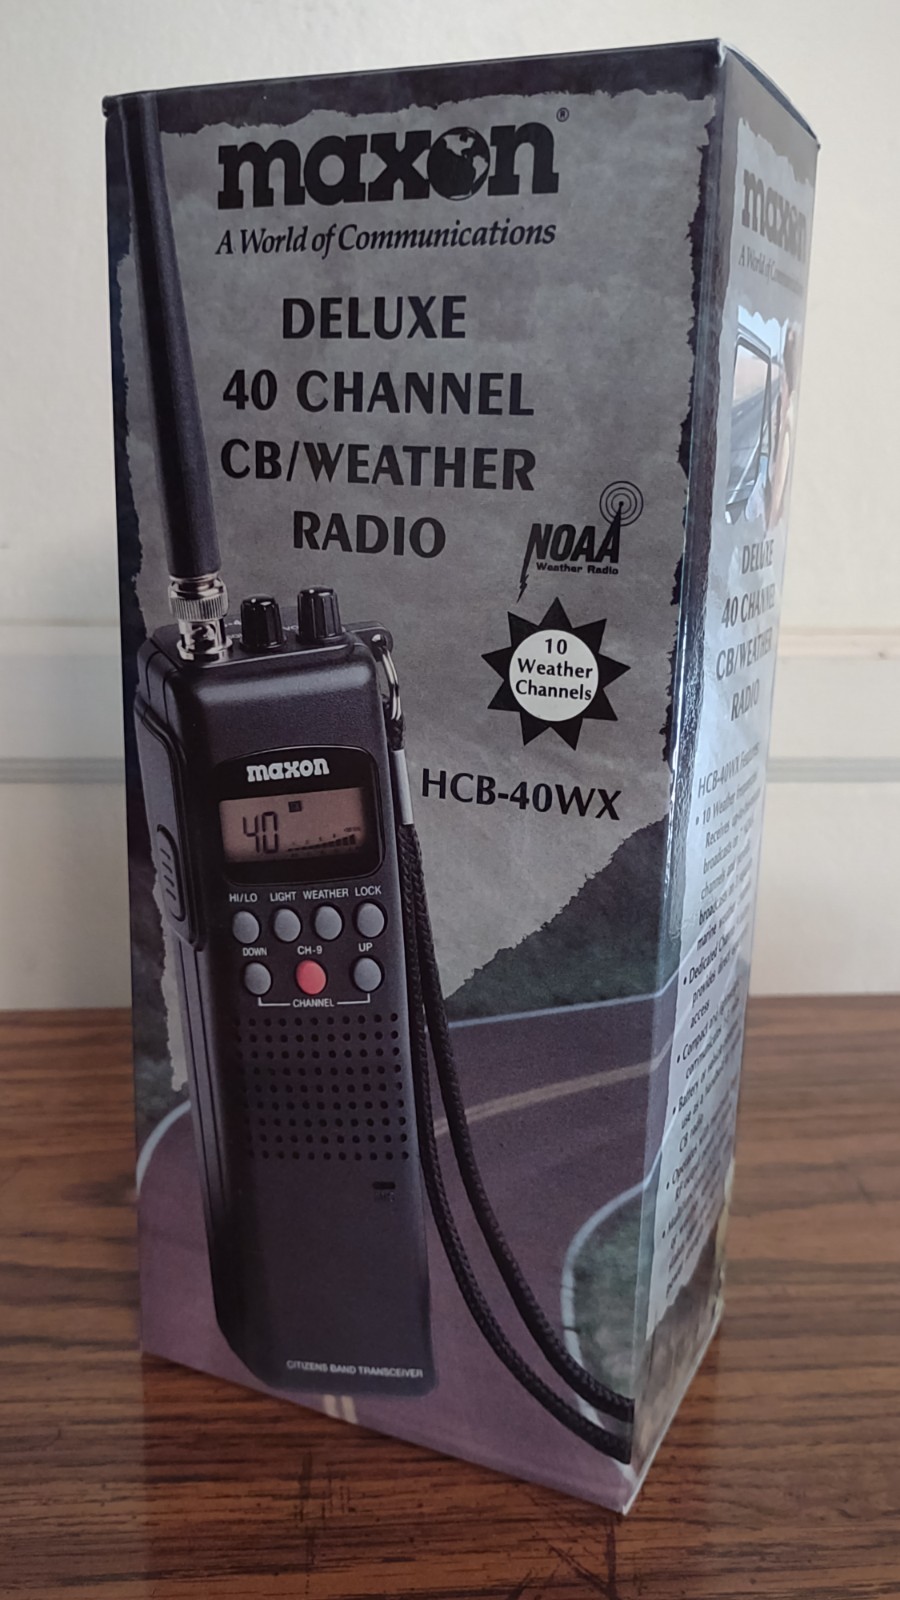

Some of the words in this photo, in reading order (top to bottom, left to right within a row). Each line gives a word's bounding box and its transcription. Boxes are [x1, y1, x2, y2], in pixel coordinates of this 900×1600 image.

[218, 122, 559, 209] maxon
[215, 230, 233, 254] A
[240, 226, 307, 254] World
[312, 223, 337, 259] of
[338, 218, 556, 251] Communications
[282, 295, 467, 339] DELUXE
[223, 369, 277, 410] 40
[297, 370, 534, 416] CHANNEL
[220, 438, 536, 491] CB/WEATHER
[293, 510, 446, 559] RADIO
[525, 522, 622, 564] NOAA
[536, 562, 583, 573] Weather
[587, 565, 619, 575] Radio
[721, 596, 738, 628] 40
[545, 638, 568, 655] 10
[517, 658, 593, 679] Weather
[515, 680, 592, 701] Channels
[731, 678, 760, 721] RADIO
[246, 758, 330, 782] maxon
[421, 767, 622, 821] HCB-40WX
[243, 811, 279, 853] 40
[229, 893, 258, 903] HI/LO
[270, 891, 297, 902] LIGHT
[303, 888, 349, 900] WEATHER
[355, 885, 382, 896] LOCK
[242, 947, 267, 957] DOWN
[297, 946, 323, 956] CH-9
[358, 942, 373, 952] UP
[293, 998, 334, 1008] CHANNEL
[286, 1360, 328, 1372] CITIZENS
[330, 1364, 356, 1375] BAND
[358, 1365, 424, 1379] TRANSCEIVER
